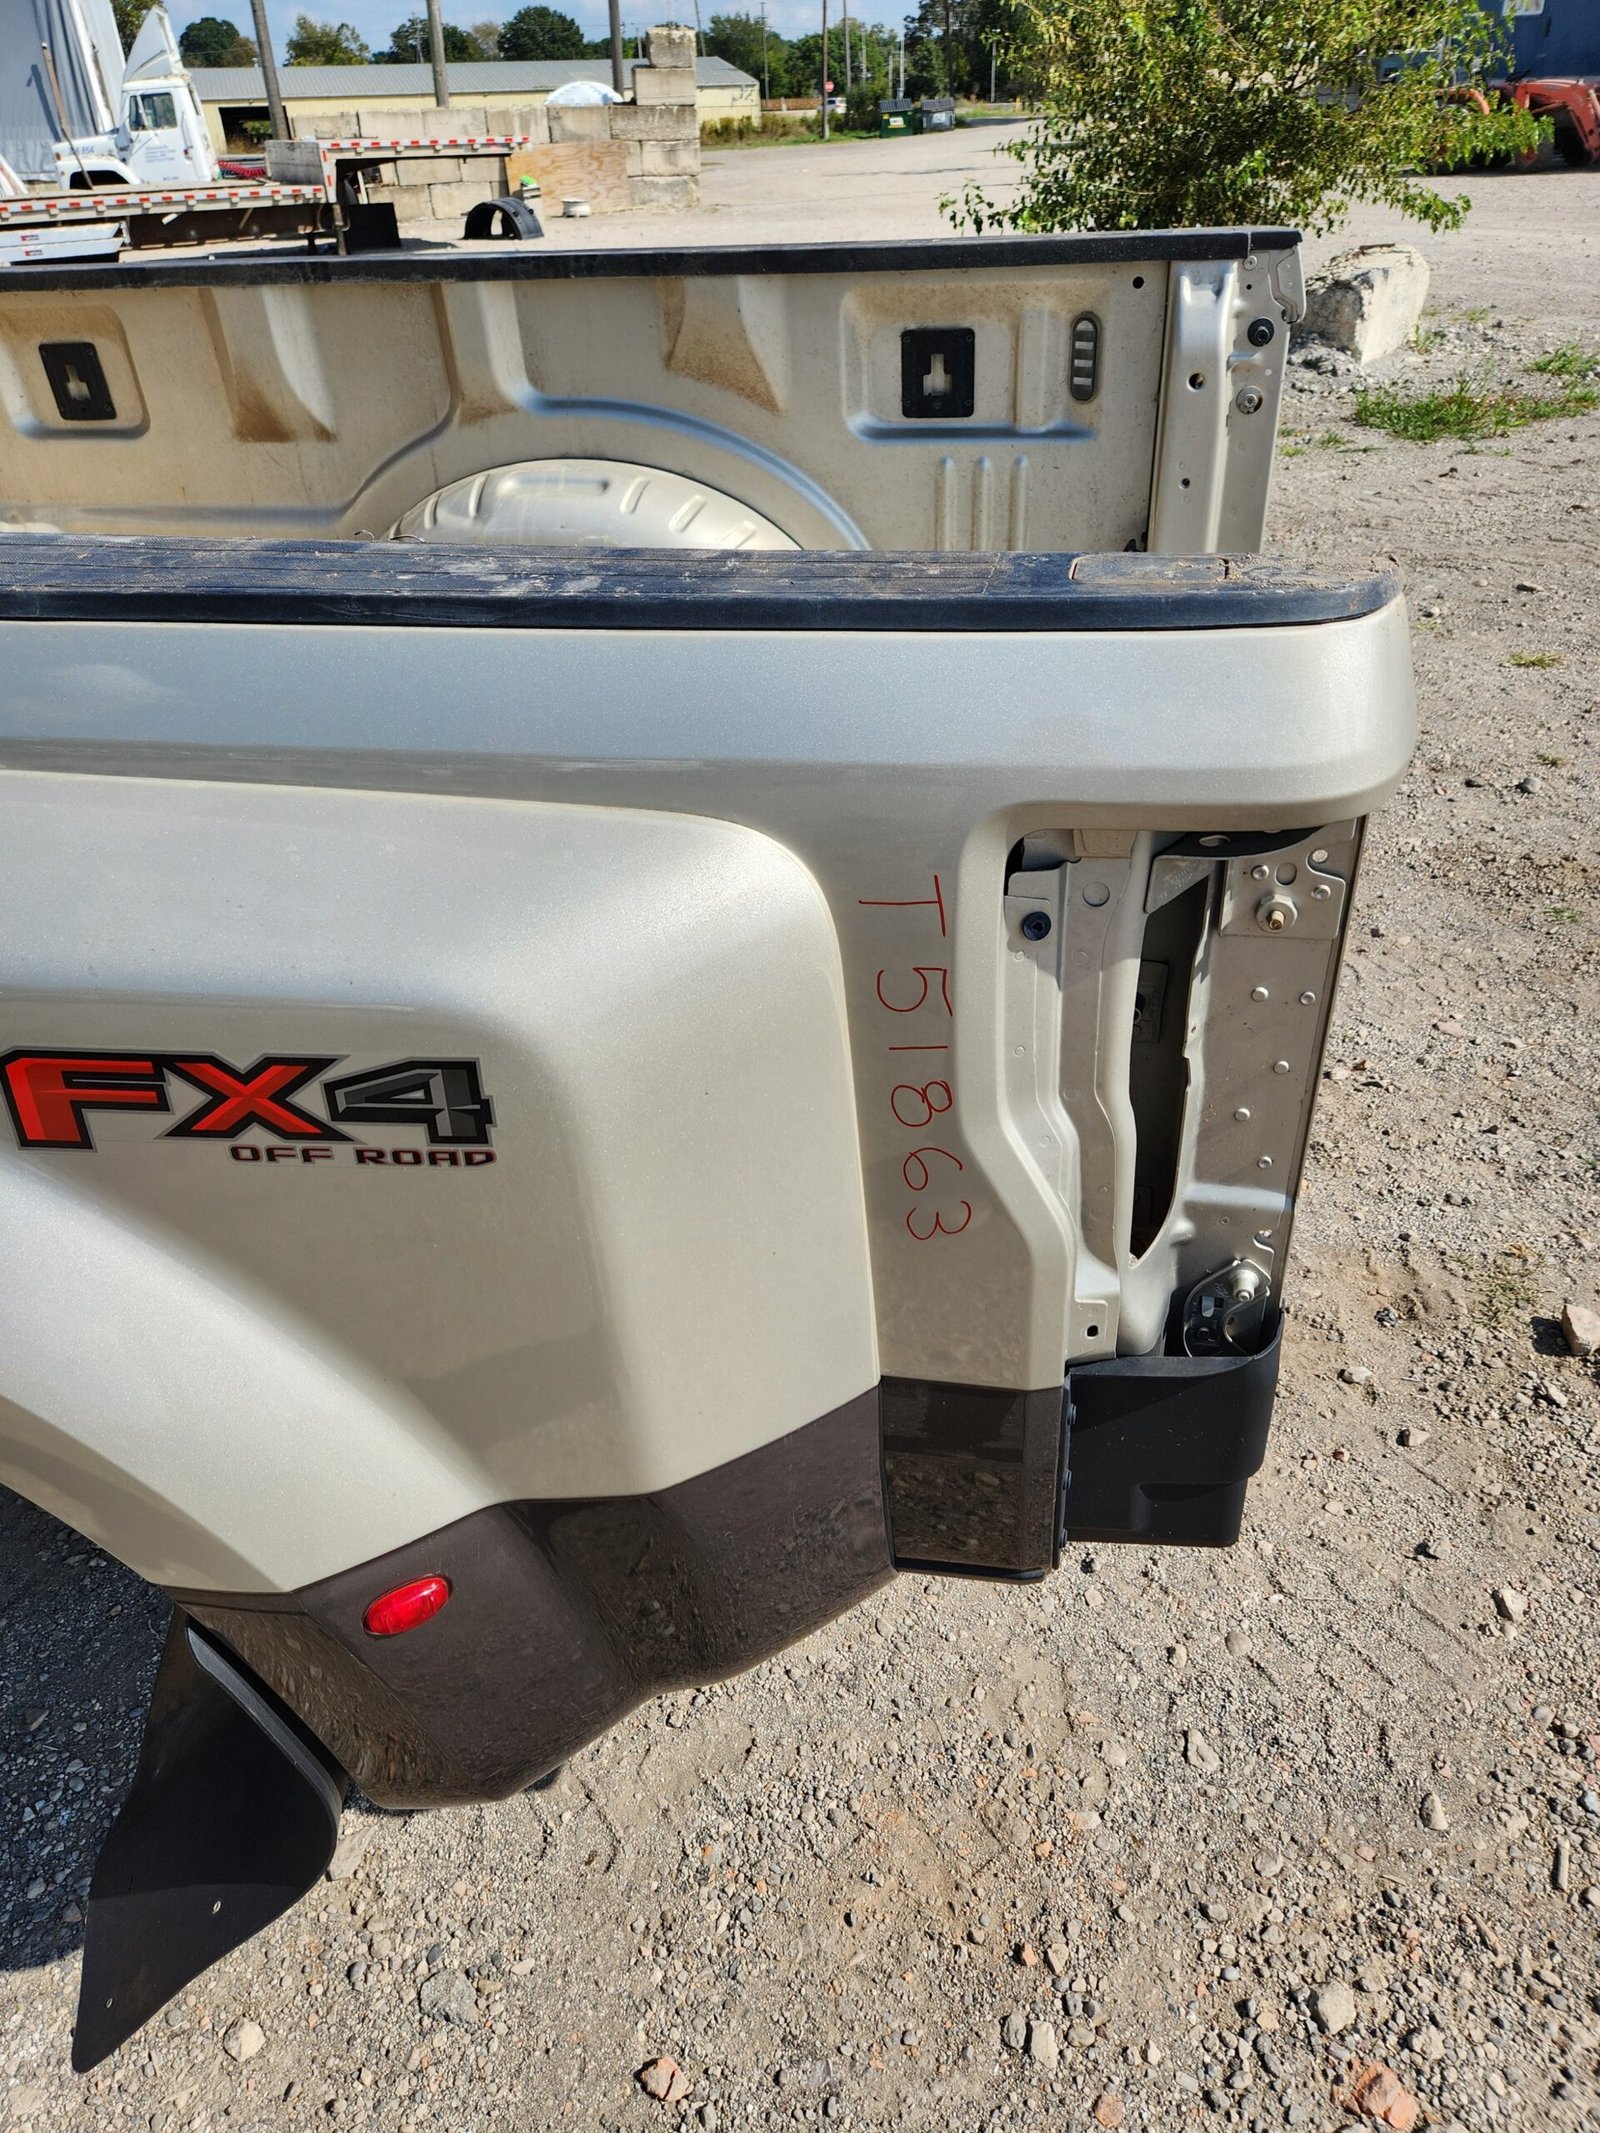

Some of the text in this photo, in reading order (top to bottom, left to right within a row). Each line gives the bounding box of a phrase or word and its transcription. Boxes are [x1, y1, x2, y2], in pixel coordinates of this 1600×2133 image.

[0, 1046, 497, 1153] FX4
[228, 1144, 497, 1168] OFF ROAD
